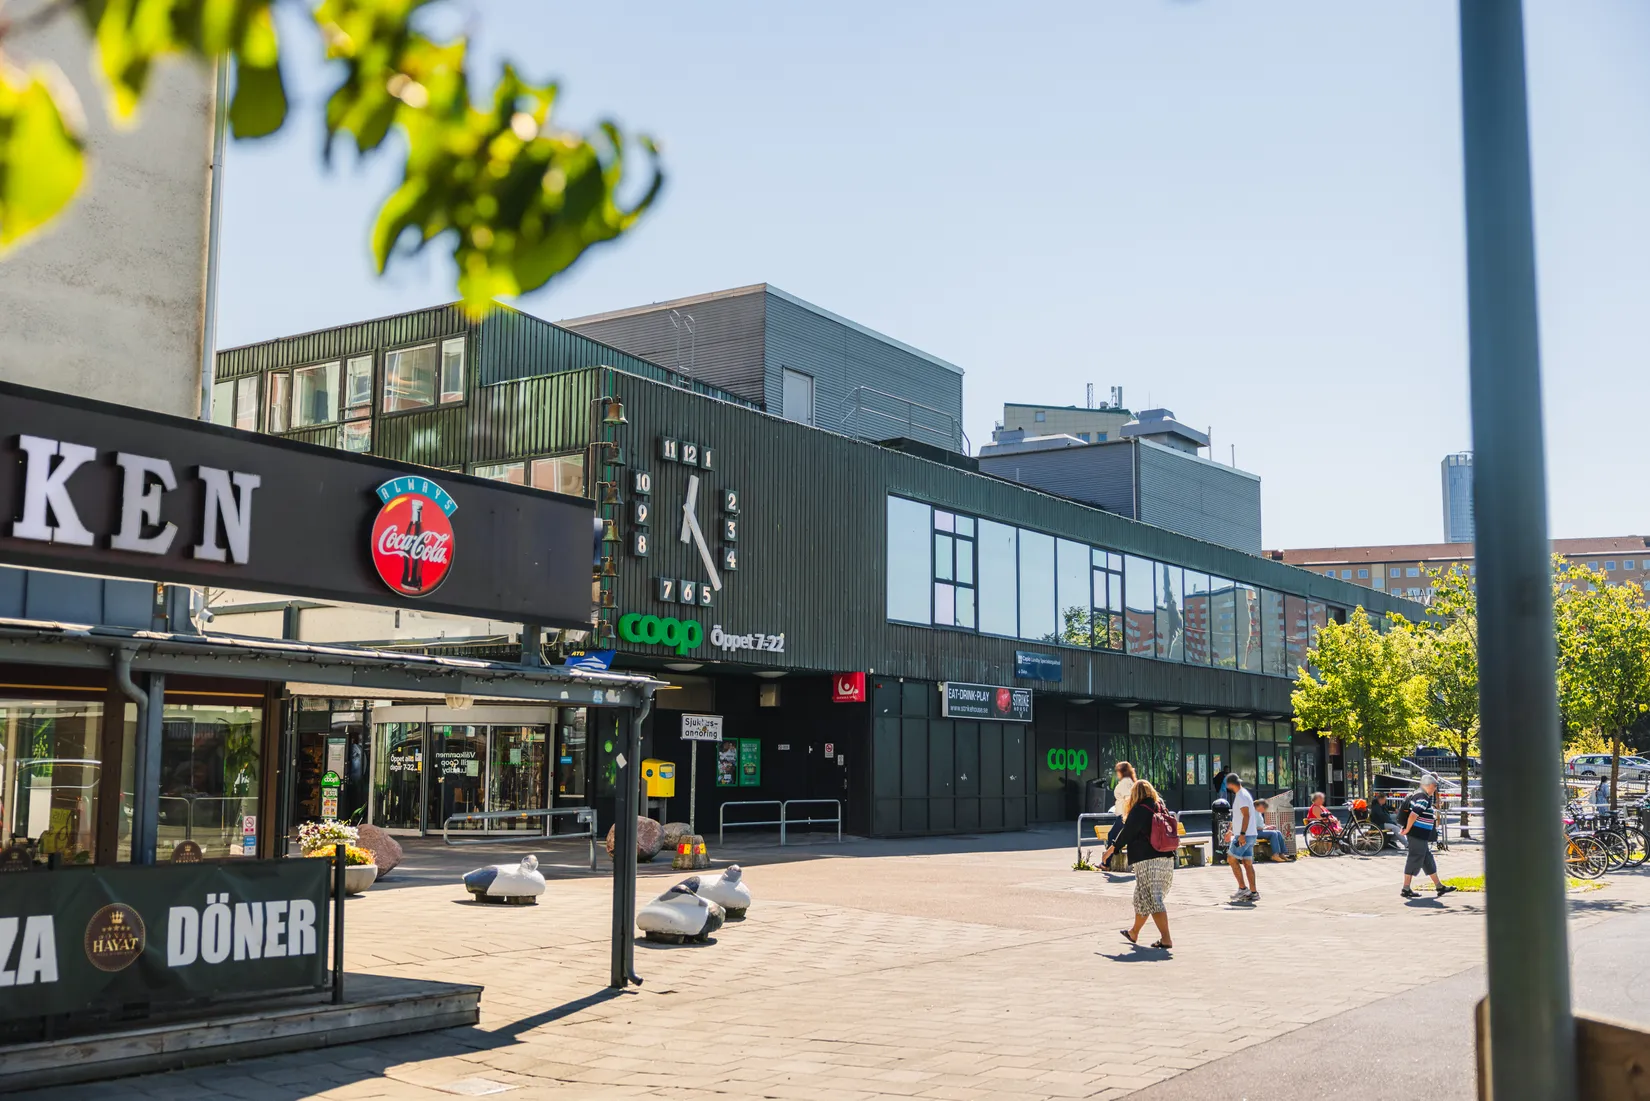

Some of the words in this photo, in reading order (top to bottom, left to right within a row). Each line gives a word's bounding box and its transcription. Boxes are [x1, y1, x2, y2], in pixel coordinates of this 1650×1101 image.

[664, 439, 676, 459] 11
[683, 444, 697, 463] 12
[705, 450, 712, 468] 1
[381, 478, 453, 510] ALWAYS
[636, 472, 651, 492] 10
[13, 434, 261, 565] KEN
[728, 492, 737, 511] 2
[637, 504, 648, 522] 9
[727, 521, 736, 539] 3
[378, 525, 450, 563] Coca-Cola
[637, 535, 647, 554] 8
[726, 550, 736, 569] 4
[663, 580, 673, 599] 7
[683, 584, 693, 601] 6
[702, 586, 711, 604] 5
[618, 613, 703, 655] coop
[710, 624, 754, 652] Öppet
[754, 633, 785, 653] 7-22
[1047, 748, 1088, 776] coop
[167, 892, 317, 967] DÖNER
[93, 937, 139, 953] HAYAT
